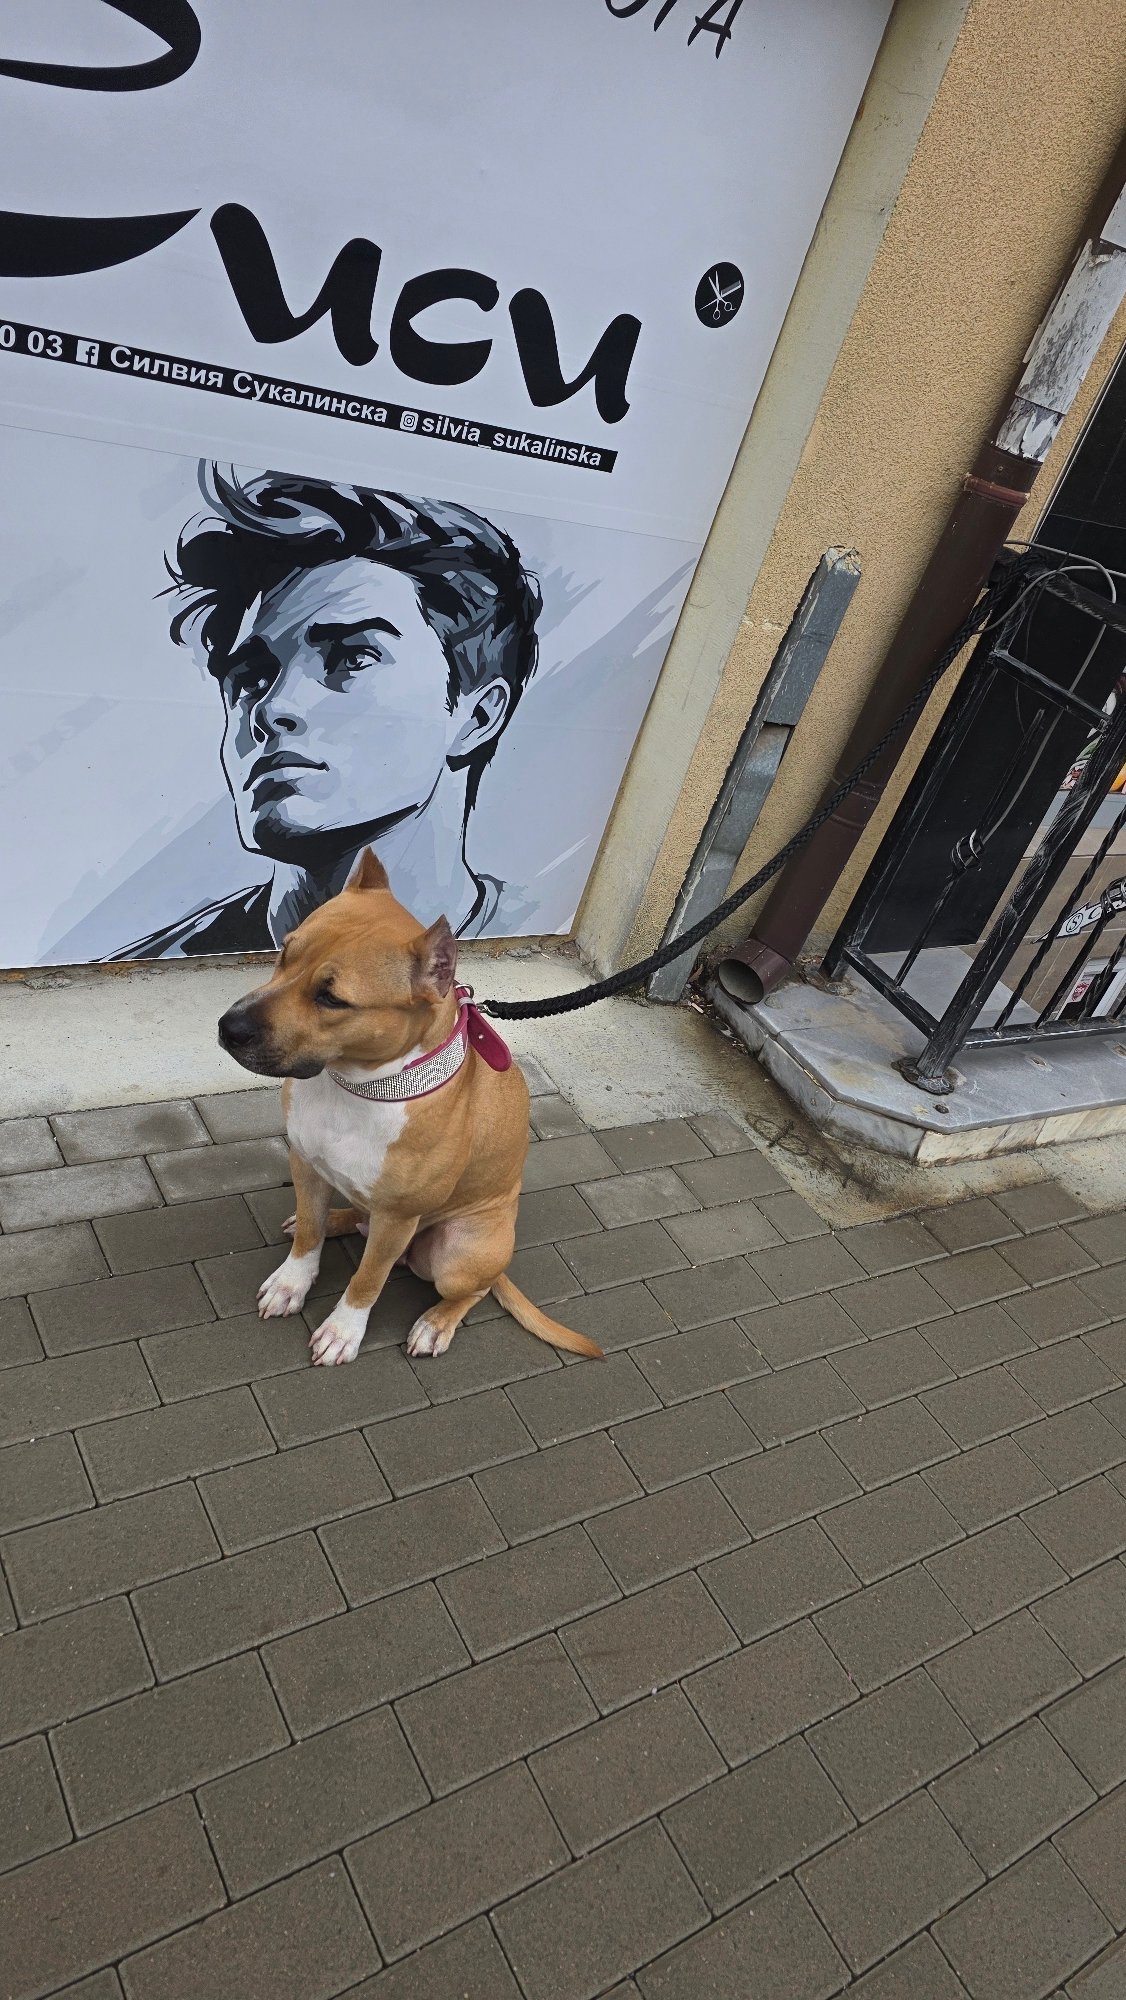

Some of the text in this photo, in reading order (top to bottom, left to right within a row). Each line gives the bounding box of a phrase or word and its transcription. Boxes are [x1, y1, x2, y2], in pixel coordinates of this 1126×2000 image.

[27, 330, 63, 358] 03
[110, 345, 224, 388] Силвия
[232, 372, 388, 423] Сукалинска
